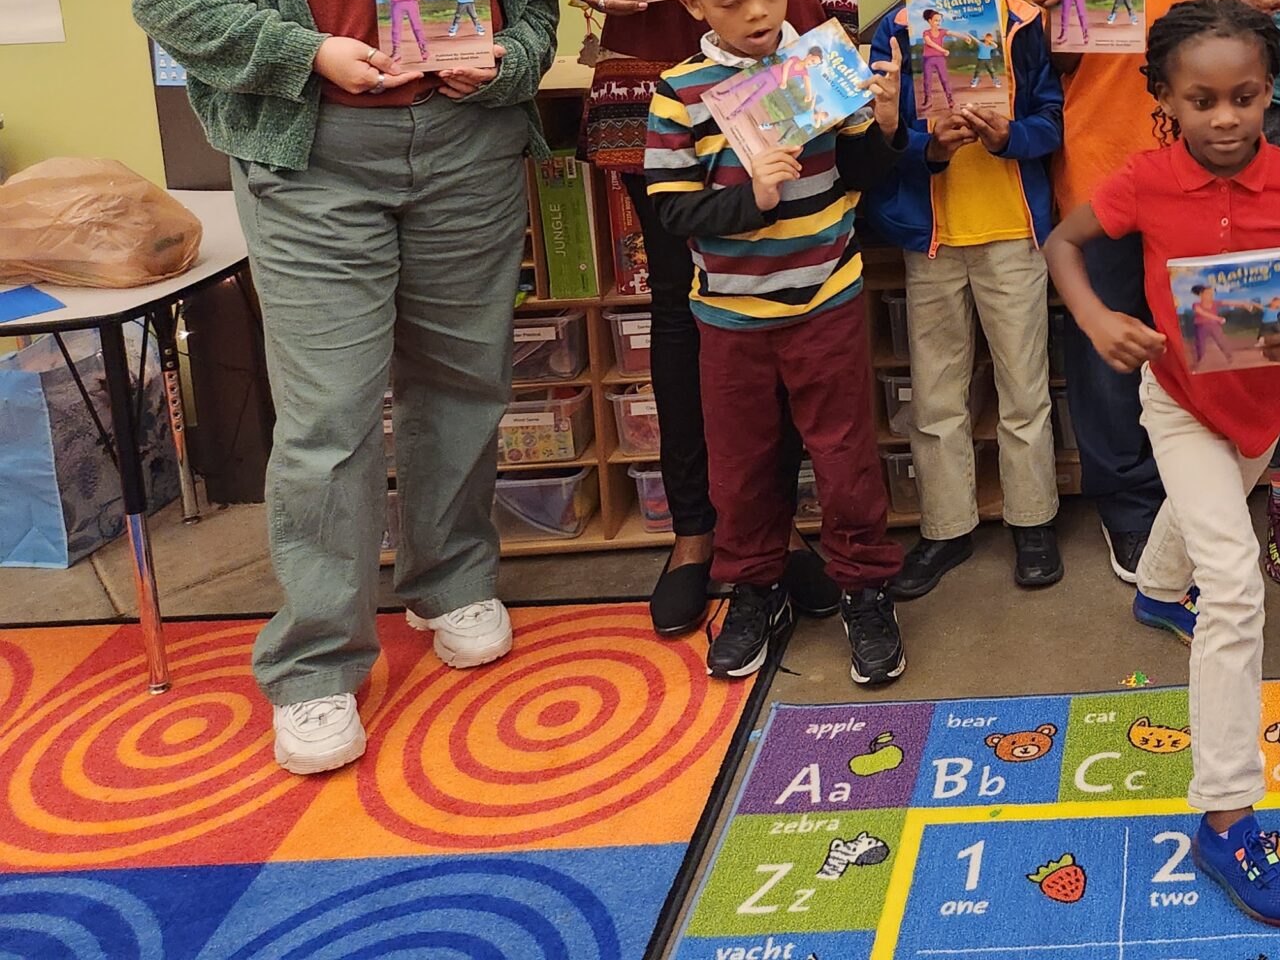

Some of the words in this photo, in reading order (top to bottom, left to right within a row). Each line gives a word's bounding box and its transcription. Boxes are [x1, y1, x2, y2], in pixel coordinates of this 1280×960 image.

[550, 203, 566, 256] JUNGLE
[1269, 542, 1280, 565] JUST
[946, 713, 998, 728] bear
[1083, 711, 1117, 724] cat
[805, 718, 866, 740] apple
[769, 814, 840, 835] zebra
[957, 840, 985, 891] 1
[1151, 831, 1196, 883] 2
[940, 898, 989, 916] one
[1149, 890, 1199, 908] two
[715, 938, 797, 960] yacht
